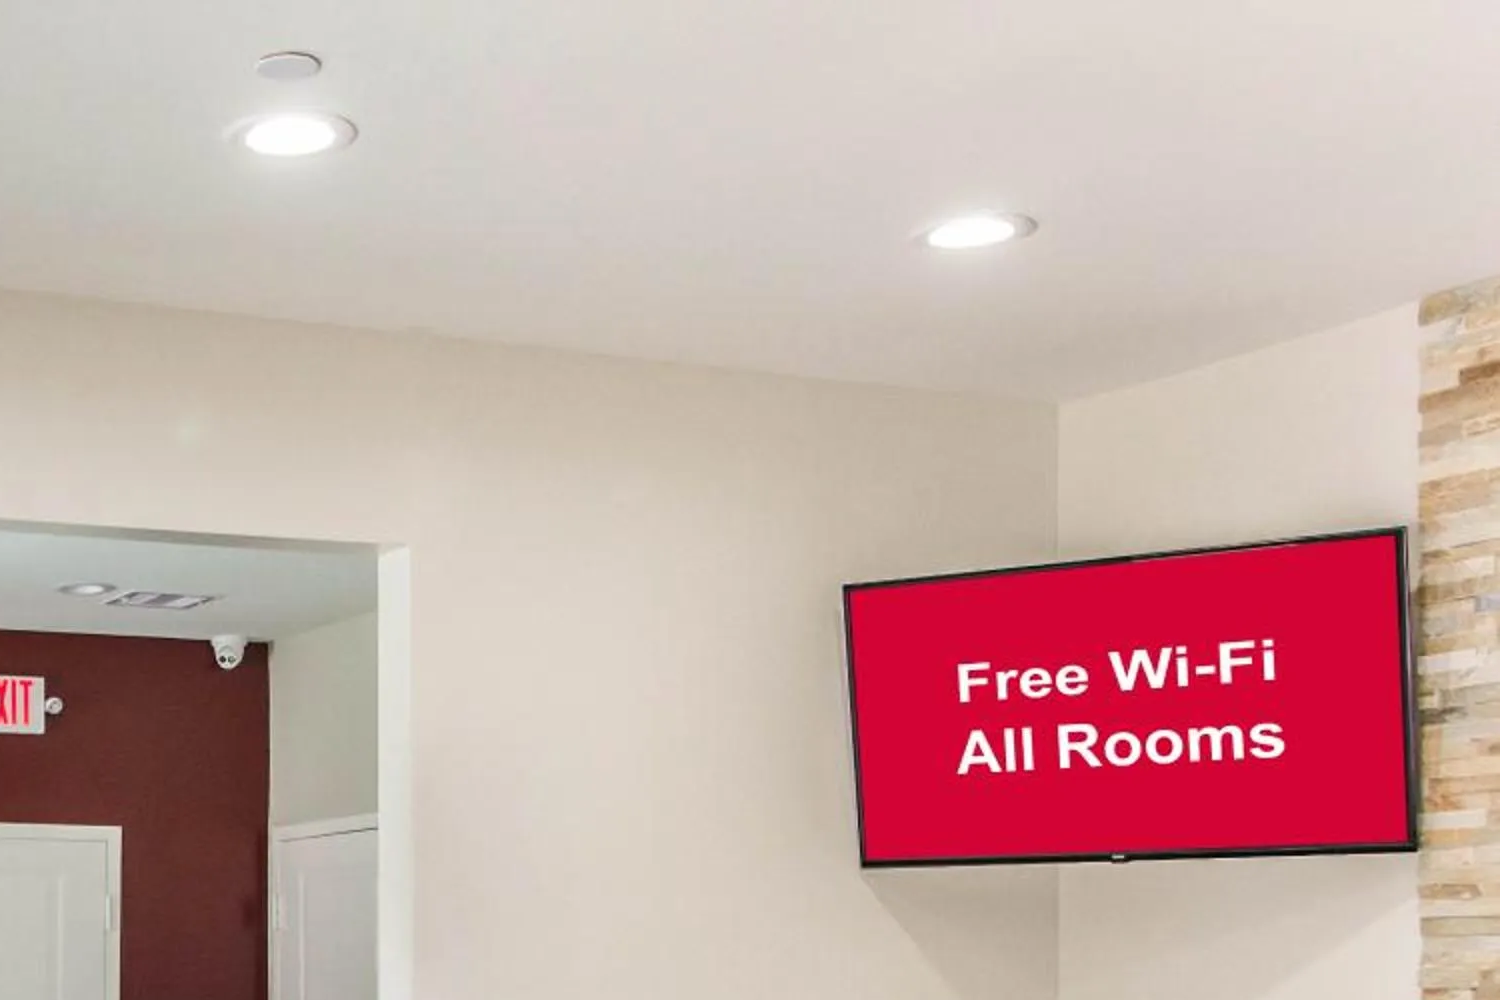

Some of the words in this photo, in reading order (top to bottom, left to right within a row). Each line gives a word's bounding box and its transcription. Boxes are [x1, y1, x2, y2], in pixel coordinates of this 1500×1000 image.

[957, 661, 1089, 703] Free
[1107, 638, 1276, 692] Wi-Fi
[957, 727, 1035, 775] All
[1057, 722, 1285, 769] Rooms
